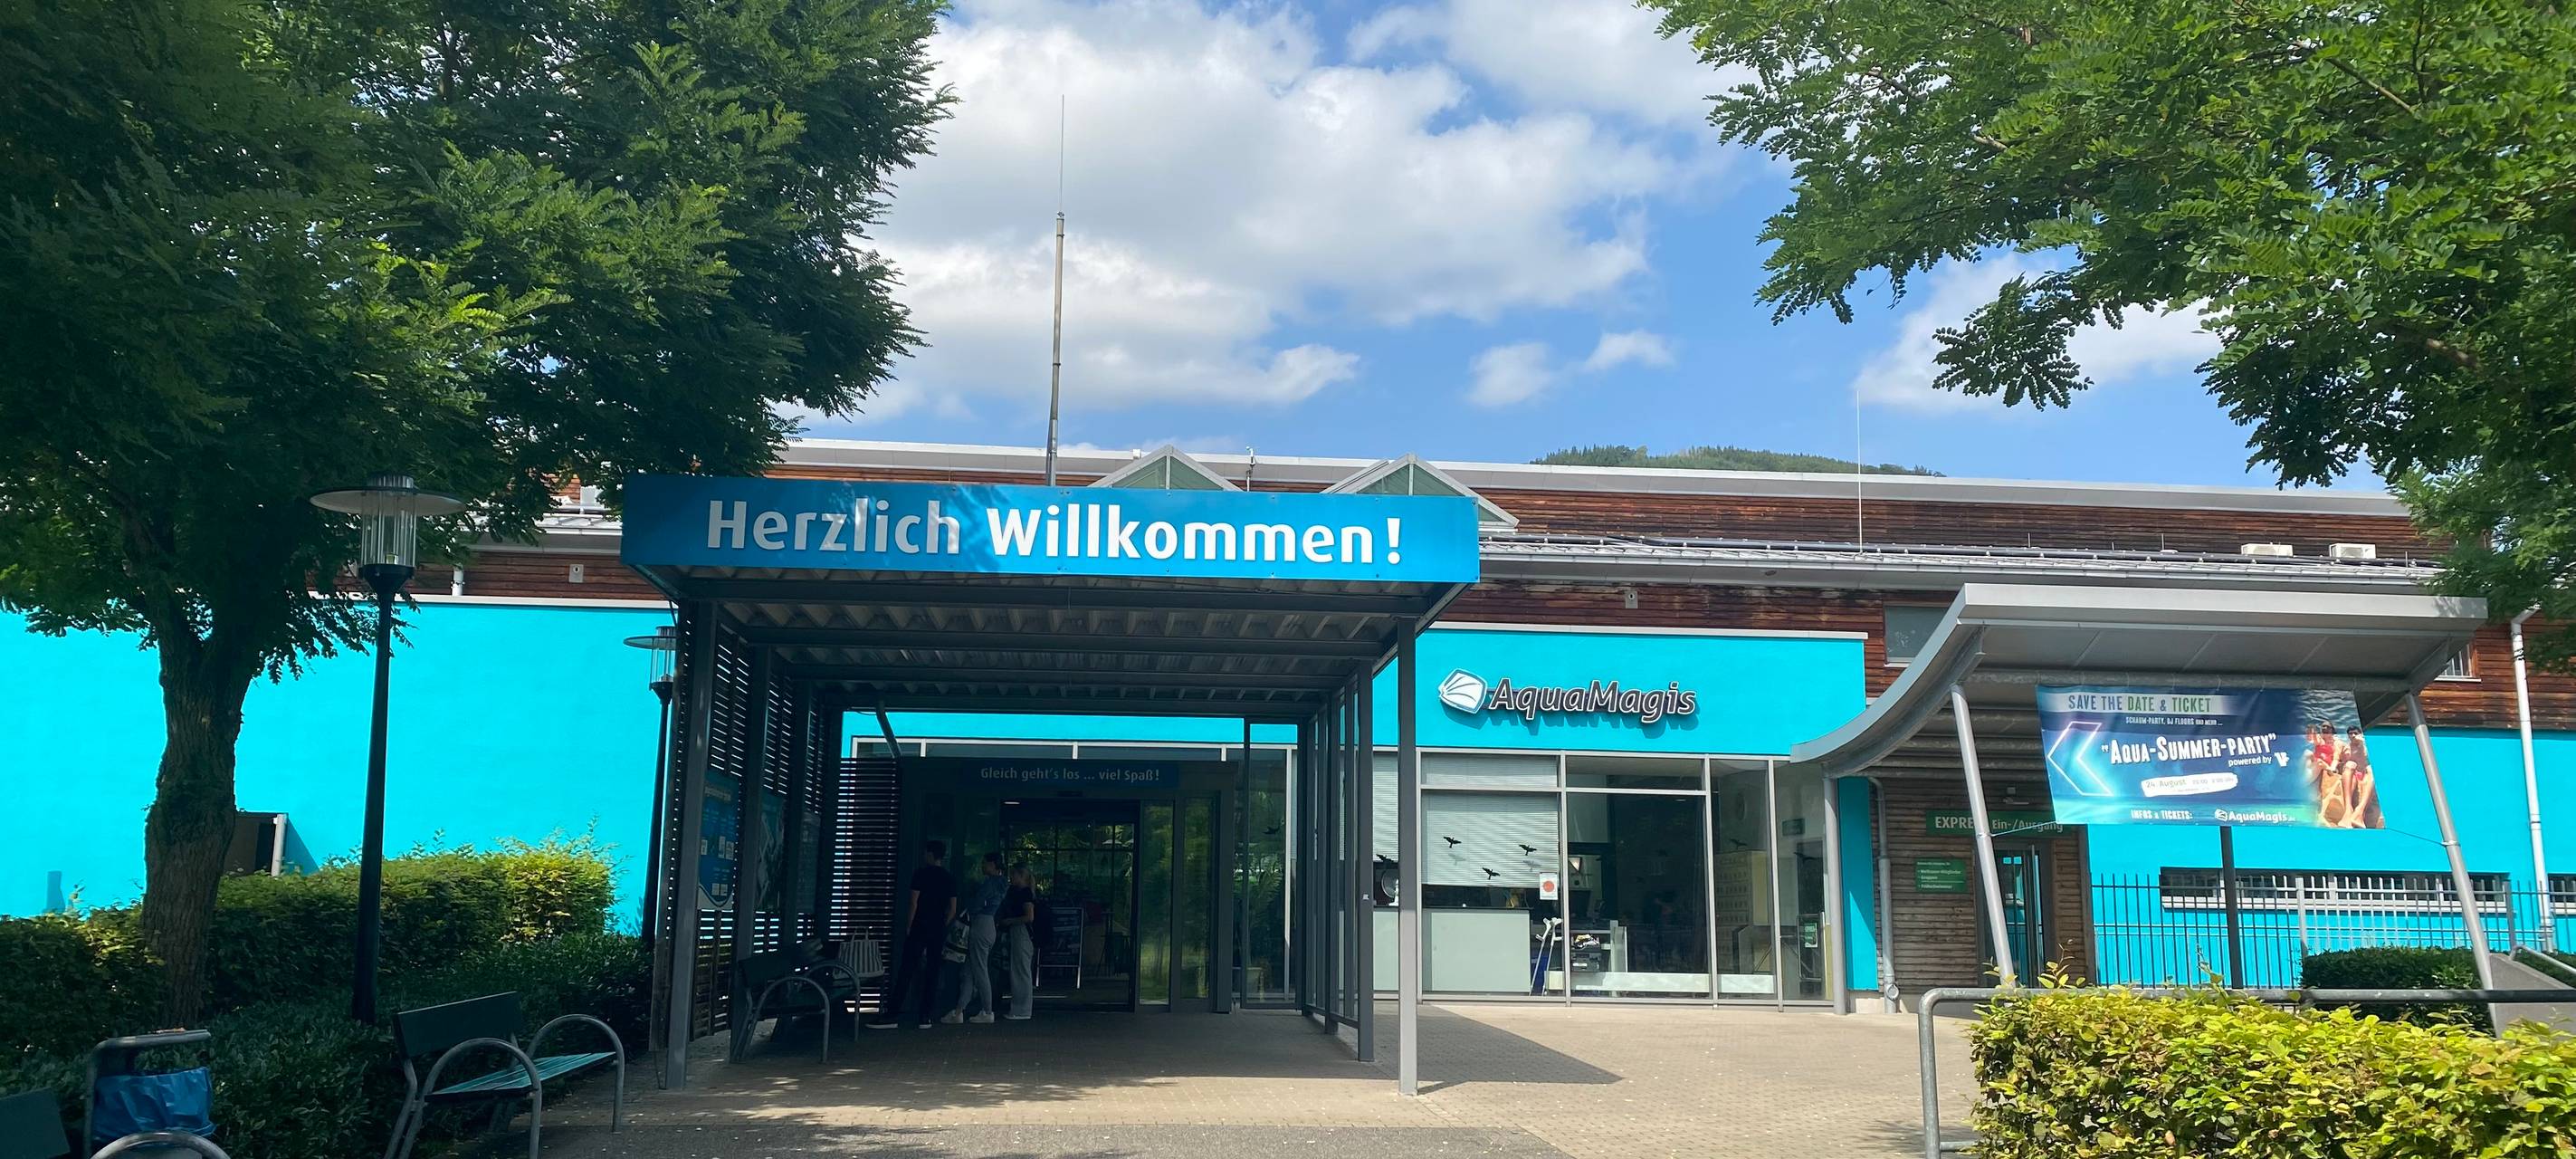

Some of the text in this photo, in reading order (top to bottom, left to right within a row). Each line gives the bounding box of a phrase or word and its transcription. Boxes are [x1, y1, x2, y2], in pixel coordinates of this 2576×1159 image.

[706, 497, 1402, 565] Herzlich Willkommen!
[1488, 676, 1697, 723] AquaMagis
[2068, 694, 2211, 713] SAVE THE DATE & TICKET
[2228, 755, 2263, 768] powered
[2263, 754, 2273, 766] by
[980, 768, 1017, 779] Gleich
[1063, 768, 1080, 780] los
[1099, 769, 1121, 781] viel
[1124, 769, 1159, 783] Spaß!
[1935, 816, 1974, 829] EXPRE
